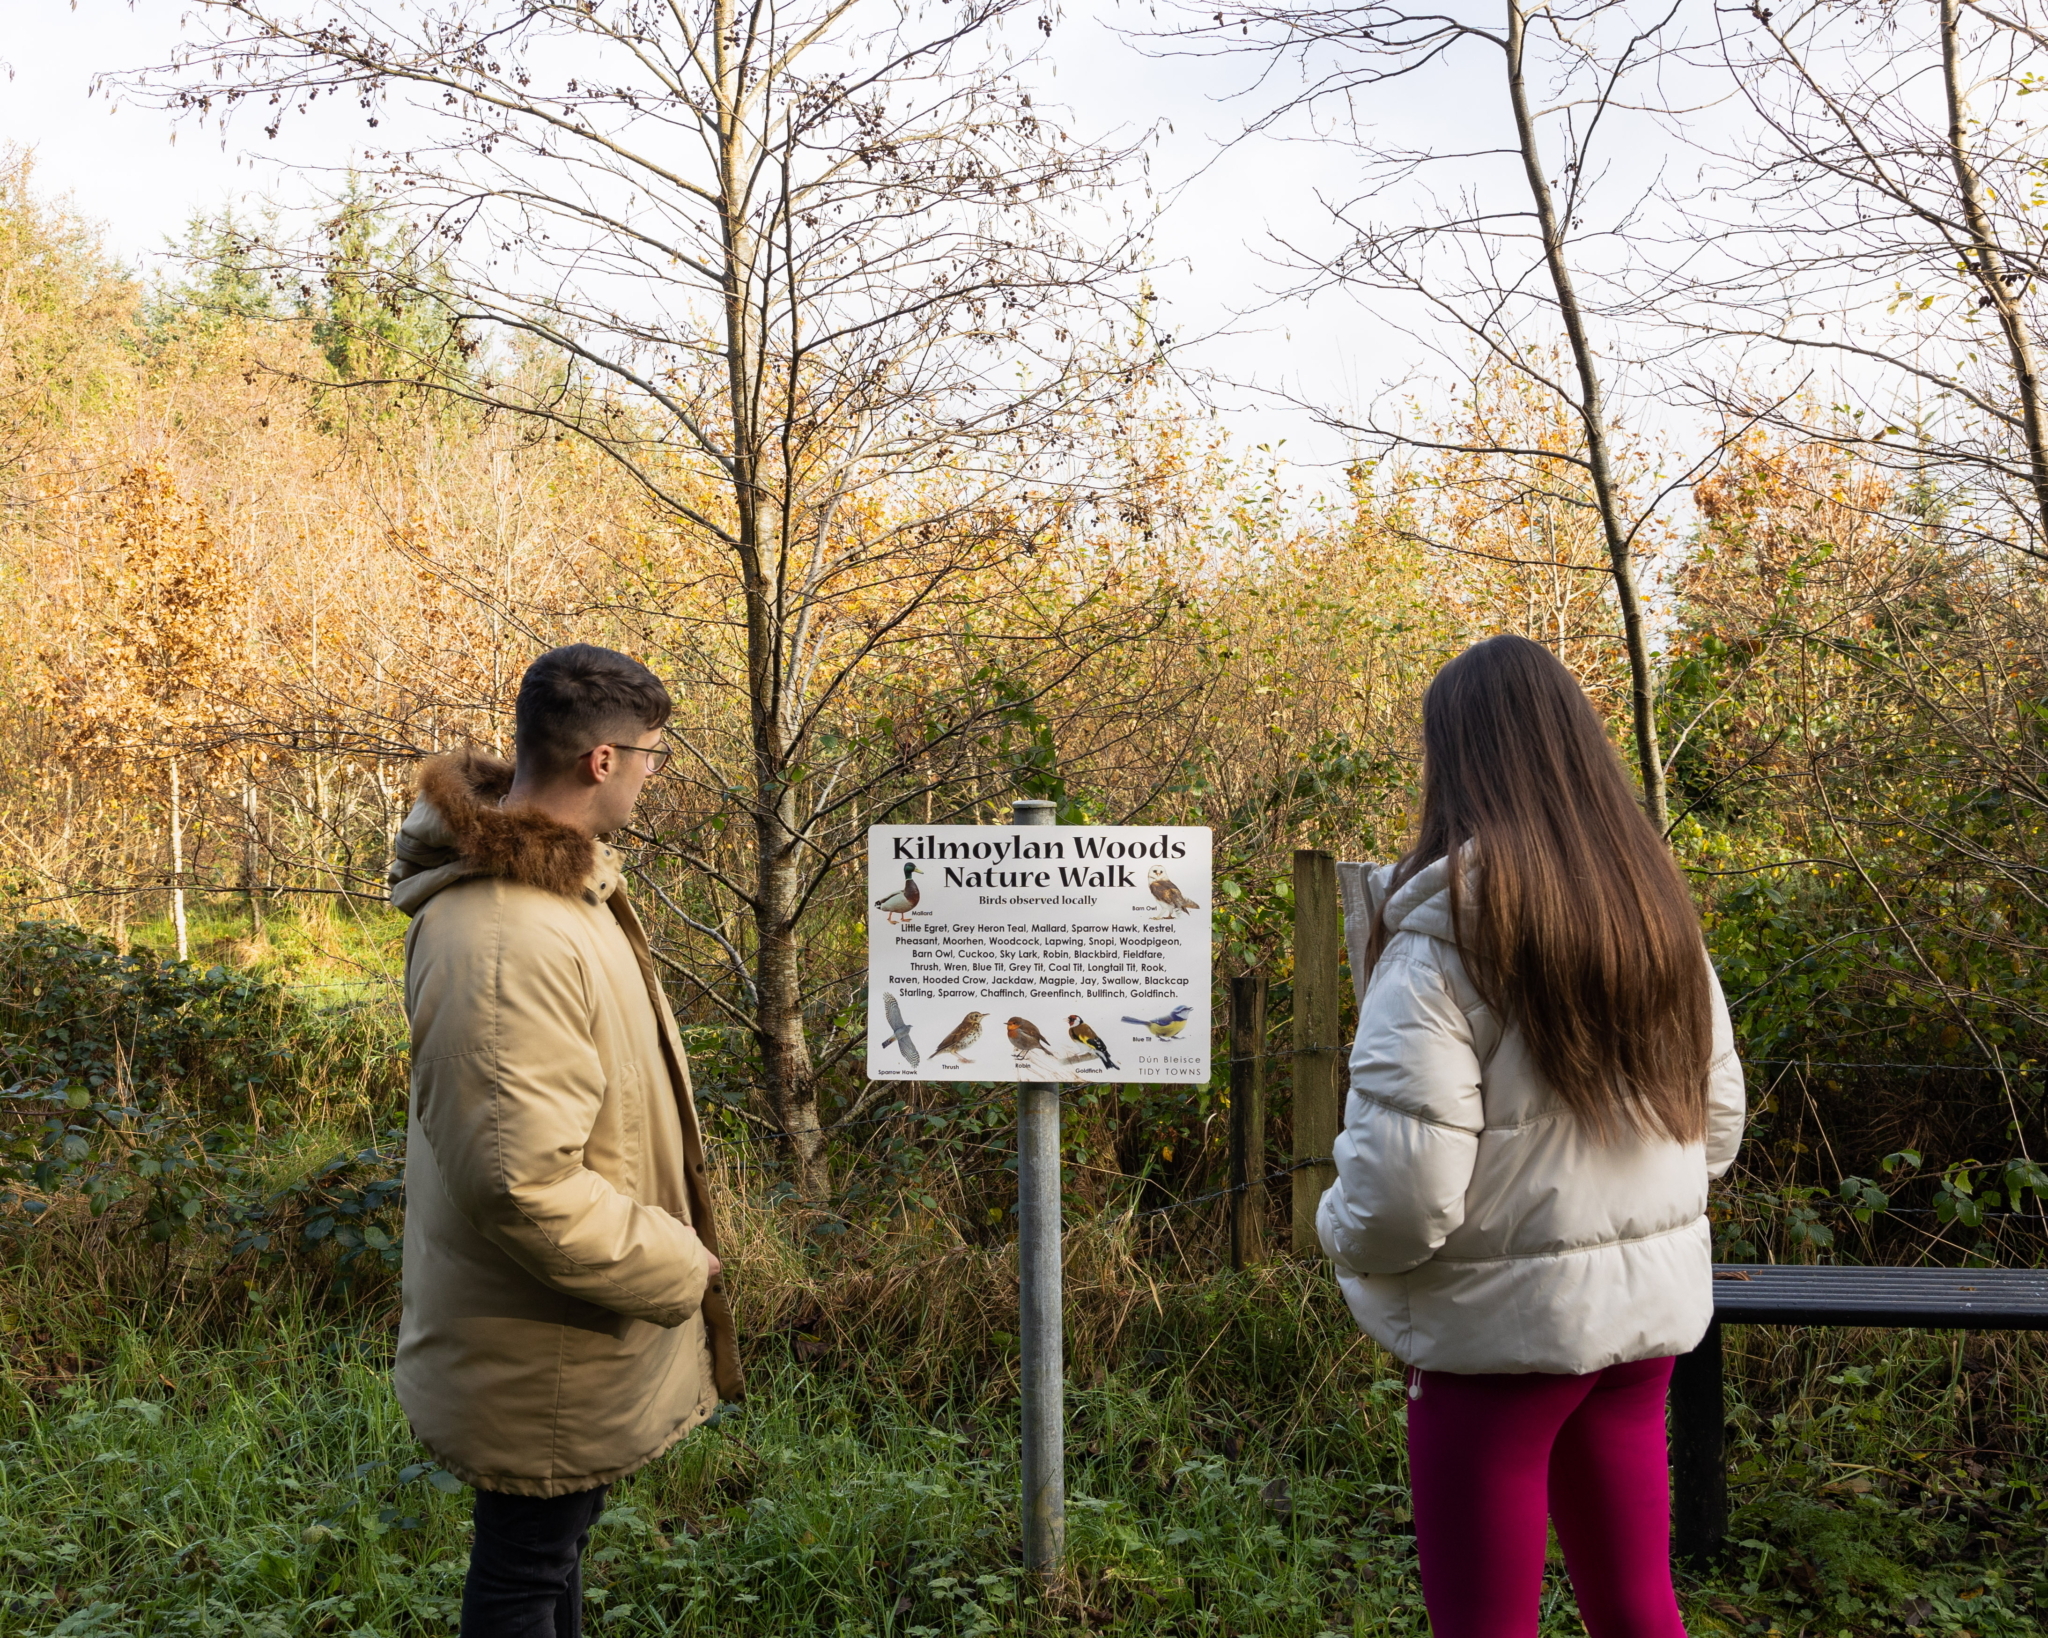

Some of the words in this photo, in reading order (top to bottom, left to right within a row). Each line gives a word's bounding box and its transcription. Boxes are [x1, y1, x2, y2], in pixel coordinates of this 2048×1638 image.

[893, 835, 1065, 865] Kilmoylan
[1073, 834, 1186, 859] Woods
[943, 866, 1050, 888] Nature
[1058, 865, 1136, 888] Walk
[979, 895, 1007, 905] Birds
[1009, 895, 1059, 905] observed
[1062, 895, 1098, 907] locally
[901, 923, 922, 933] Little
[924, 923, 950, 934] Egret,
[952, 923, 975, 934] Grey
[977, 924, 1005, 933] Heron
[1007, 923, 1029, 933] Teal,
[1031, 924, 1069, 933] Mallard,
[1071, 923, 1109, 934] Sparrow
[1111, 924, 1140, 933] Hawk,
[1143, 924, 1176, 933] Kestrel,
[895, 936, 940, 946] Pheasant,
[942, 936, 986, 946] Moorhen,
[988, 936, 1042, 946] Woodcock,
[1045, 936, 1086, 948] Lapwing,
[1088, 936, 1117, 947] Snopi,
[1119, 937, 1182, 948] Woodpigeon,
[912, 949, 933, 958] Barn
[935, 949, 955, 959] Owl,
[958, 949, 997, 959] Cuckoo,
[1000, 949, 1016, 960] Sky
[1018, 949, 1040, 959] Lark,
[1043, 949, 1071, 959] Robin,
[1074, 950, 1120, 959] Blackbird,
[1123, 950, 1165, 959] Fieldfare,
[910, 962, 941, 972] Thrush,
[943, 962, 970, 972] Wren,
[972, 962, 992, 972] Blue
[994, 962, 1006, 972] Tit,
[1008, 962, 1032, 973] Grey
[1033, 962, 1046, 972] Tit,
[1048, 962, 1071, 972] Coal
[1073, 963, 1085, 972] Tit,
[1087, 963, 1124, 974] Longtail
[1126, 963, 1138, 973] Tit,
[1141, 963, 1167, 972] Rook,
[889, 975, 920, 985] Raven,
[922, 975, 960, 984] Hooded
[962, 975, 989, 985] Crow,
[991, 975, 1037, 985] Jackdaw,
[1039, 976, 1078, 987] Magpie,
[1080, 976, 1099, 986] Jay,
[1102, 976, 1142, 985] Swallow,
[1144, 976, 1189, 987] Blackcap
[899, 988, 935, 999] Starling,
[938, 988, 978, 999] Sparrow,
[980, 988, 1027, 998] Chaffinch,
[1029, 988, 1084, 998] Greenfinch,
[1086, 989, 1128, 998] Bullfinch,
[1130, 989, 1178, 998] Goldfinch.
[1138, 1055, 1159, 1064] Dún
[1163, 1055, 1201, 1064] Bleisce
[1139, 1068, 1161, 1076] TIDY
[1165, 1068, 1201, 1076] TOWNS
